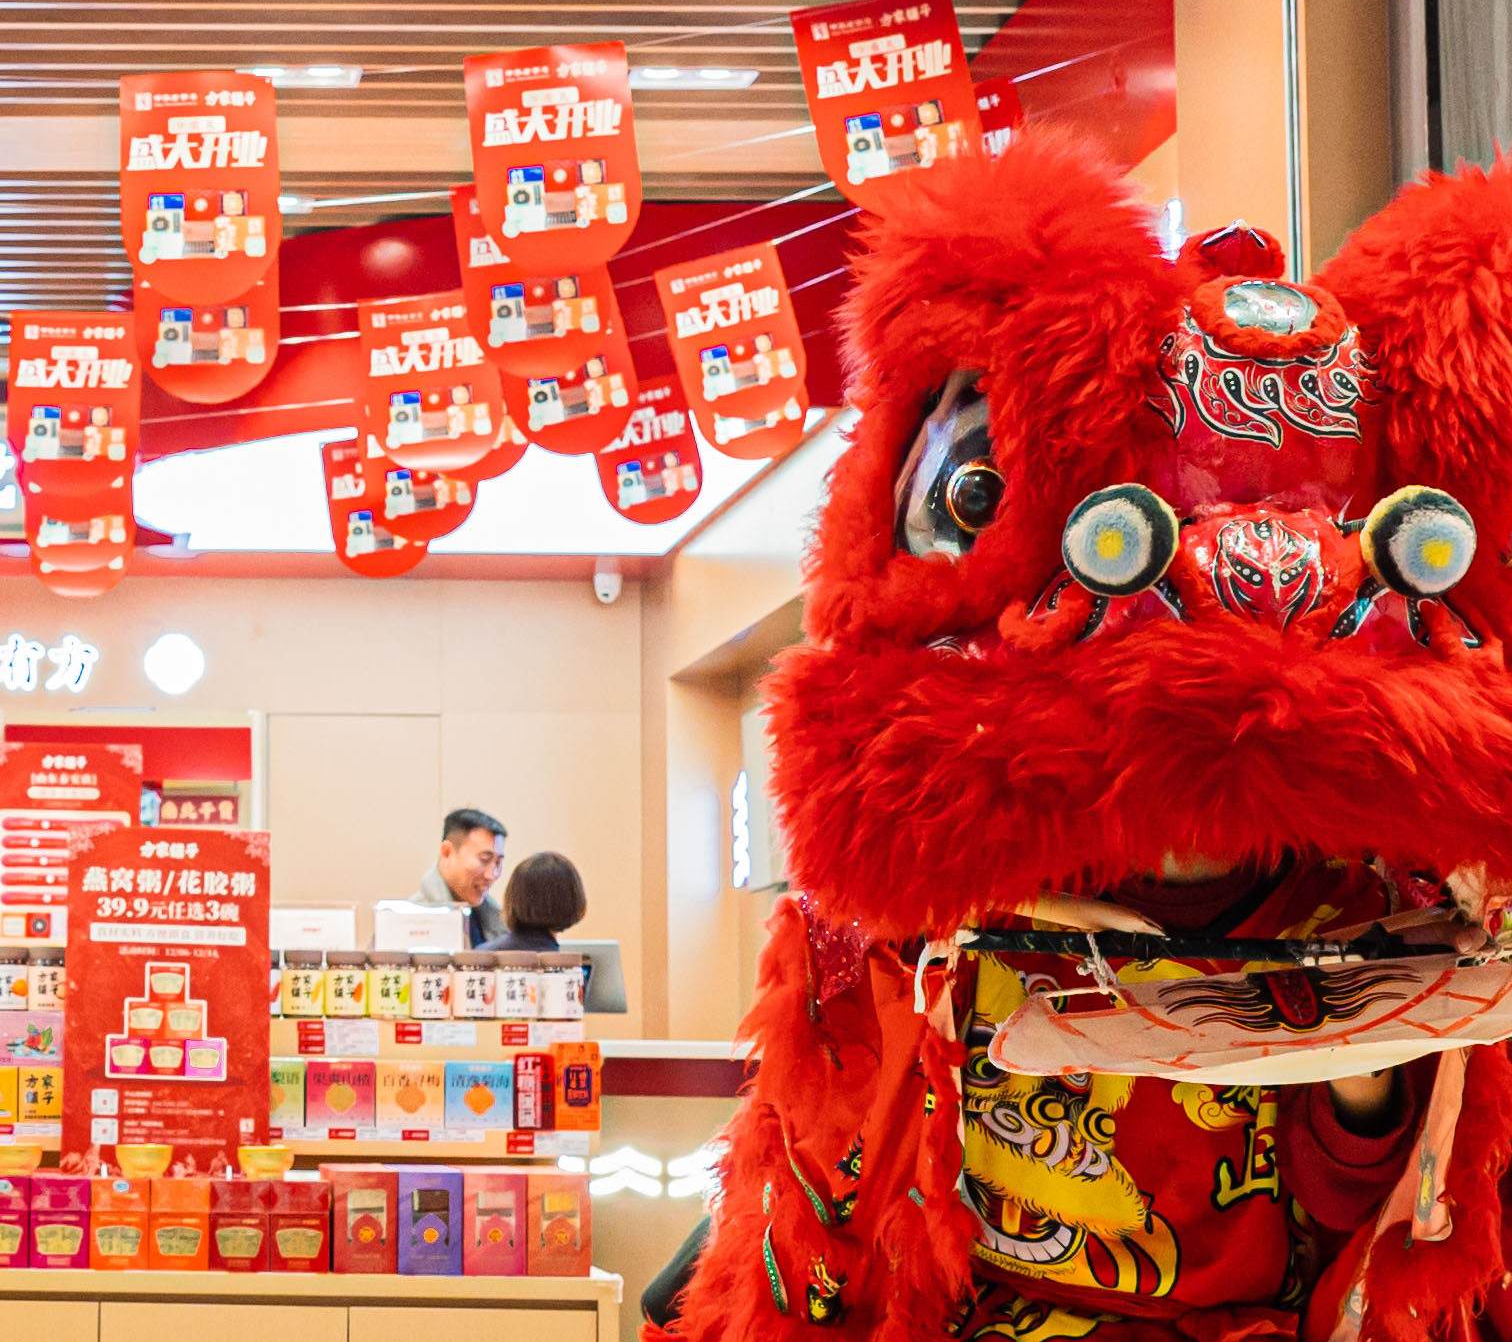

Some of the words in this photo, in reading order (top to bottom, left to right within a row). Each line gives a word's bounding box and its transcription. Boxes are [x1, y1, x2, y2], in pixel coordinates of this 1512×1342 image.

[817, 39, 953, 99] 盛大开业
[482, 99, 623, 147] 盛大开业
[126, 131, 268, 171] 盛大开业
[677, 286, 780, 339] 盛大开业
[14, 358, 133, 389] 盛大开业
[81, 866, 257, 897] 燕窝粥/花胶粥
[96, 896, 241, 923] 39.9元任选3碗
